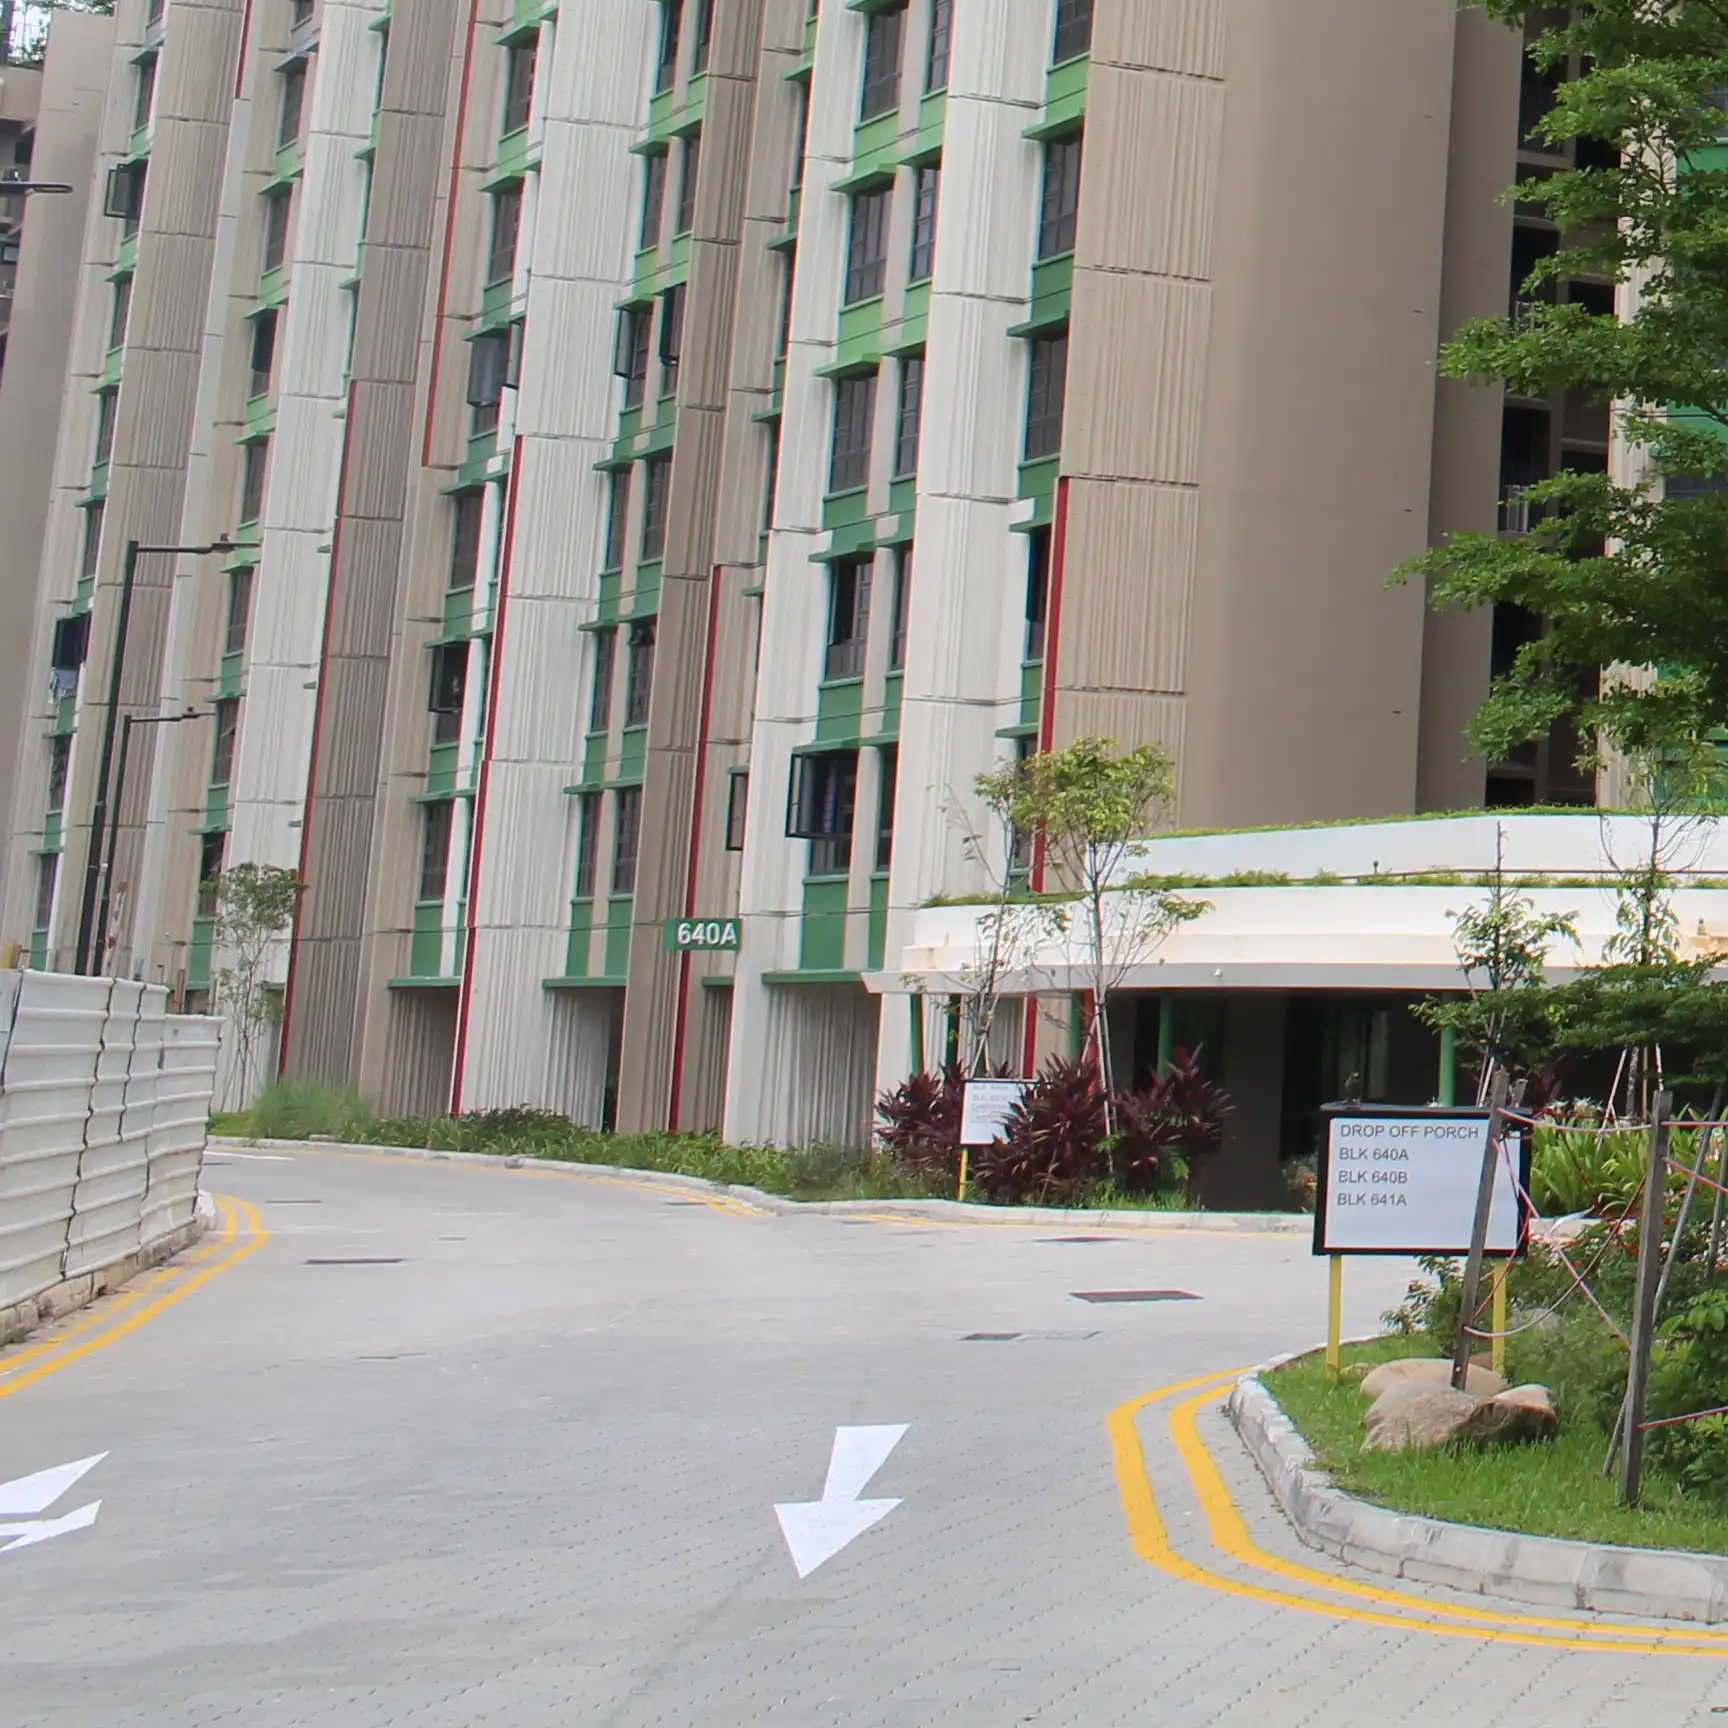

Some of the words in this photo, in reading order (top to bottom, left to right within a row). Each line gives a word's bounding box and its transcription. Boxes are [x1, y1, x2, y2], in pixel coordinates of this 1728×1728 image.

[677, 921, 738, 946] 640A
[1340, 1124, 1385, 1138] DROP
[1389, 1125, 1420, 1139] OFF
[1424, 1126, 1479, 1140] PORCH
[1339, 1147, 1369, 1161] BLK
[1373, 1148, 1410, 1161] 640A
[1338, 1170, 1368, 1184] BLK
[1371, 1170, 1408, 1184] 640B
[1337, 1193, 1367, 1206] BLK
[1370, 1193, 1408, 1207] 641A
